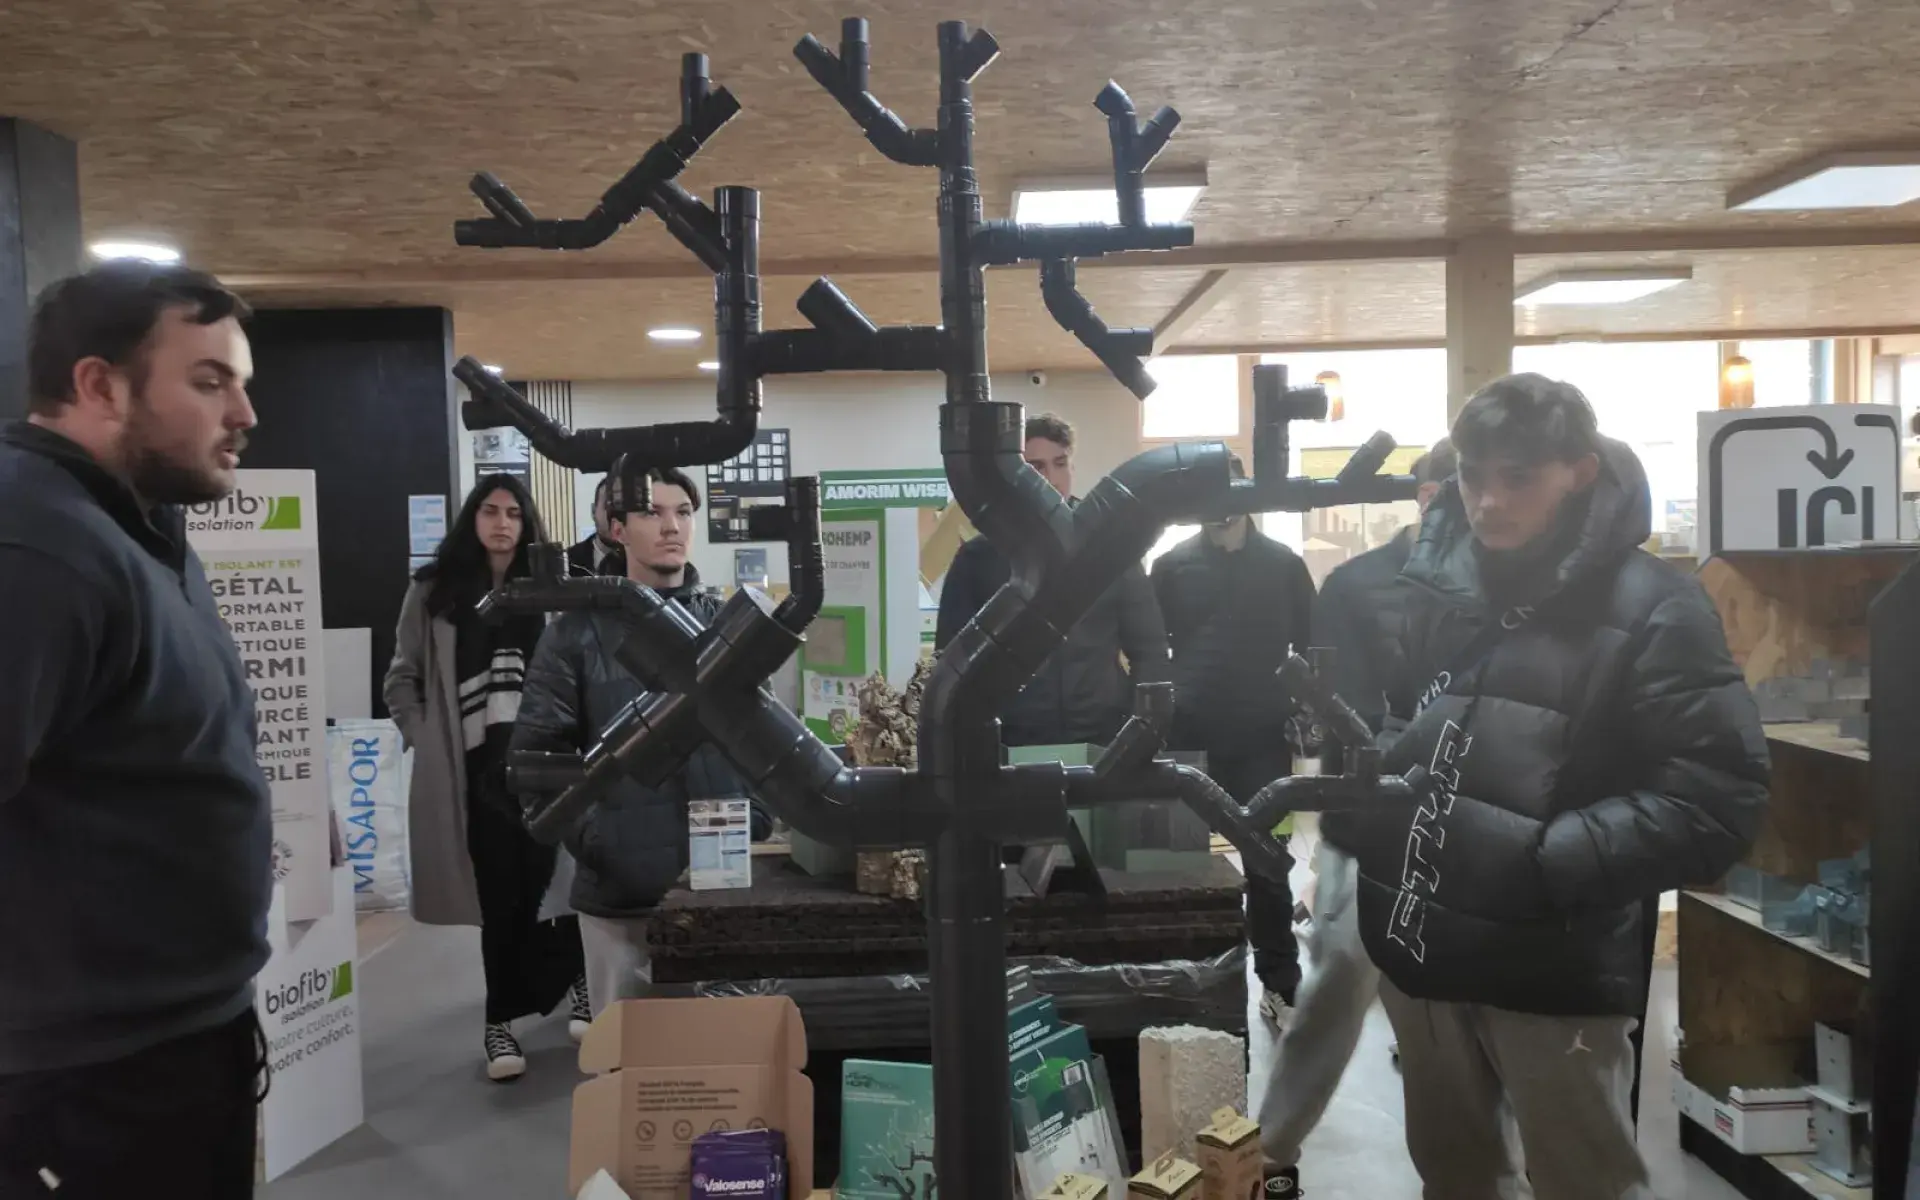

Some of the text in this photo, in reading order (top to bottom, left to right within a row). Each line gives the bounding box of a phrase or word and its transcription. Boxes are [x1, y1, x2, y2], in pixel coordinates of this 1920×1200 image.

[825, 483, 947, 499] AMORIM WISE
[187, 520, 254, 532] solation
[821, 531, 872, 547] SOHEMP
[214, 560, 273, 571] ISOLANT
[209, 572, 304, 598] GÉTAL
[219, 601, 304, 617] ORMANT
[234, 637, 307, 653] STIQUE
[243, 656, 306, 680] RMI
[258, 727, 310, 745] ANT
[260, 762, 312, 782] BLE
[703, 1177, 765, 1193] Valosense
